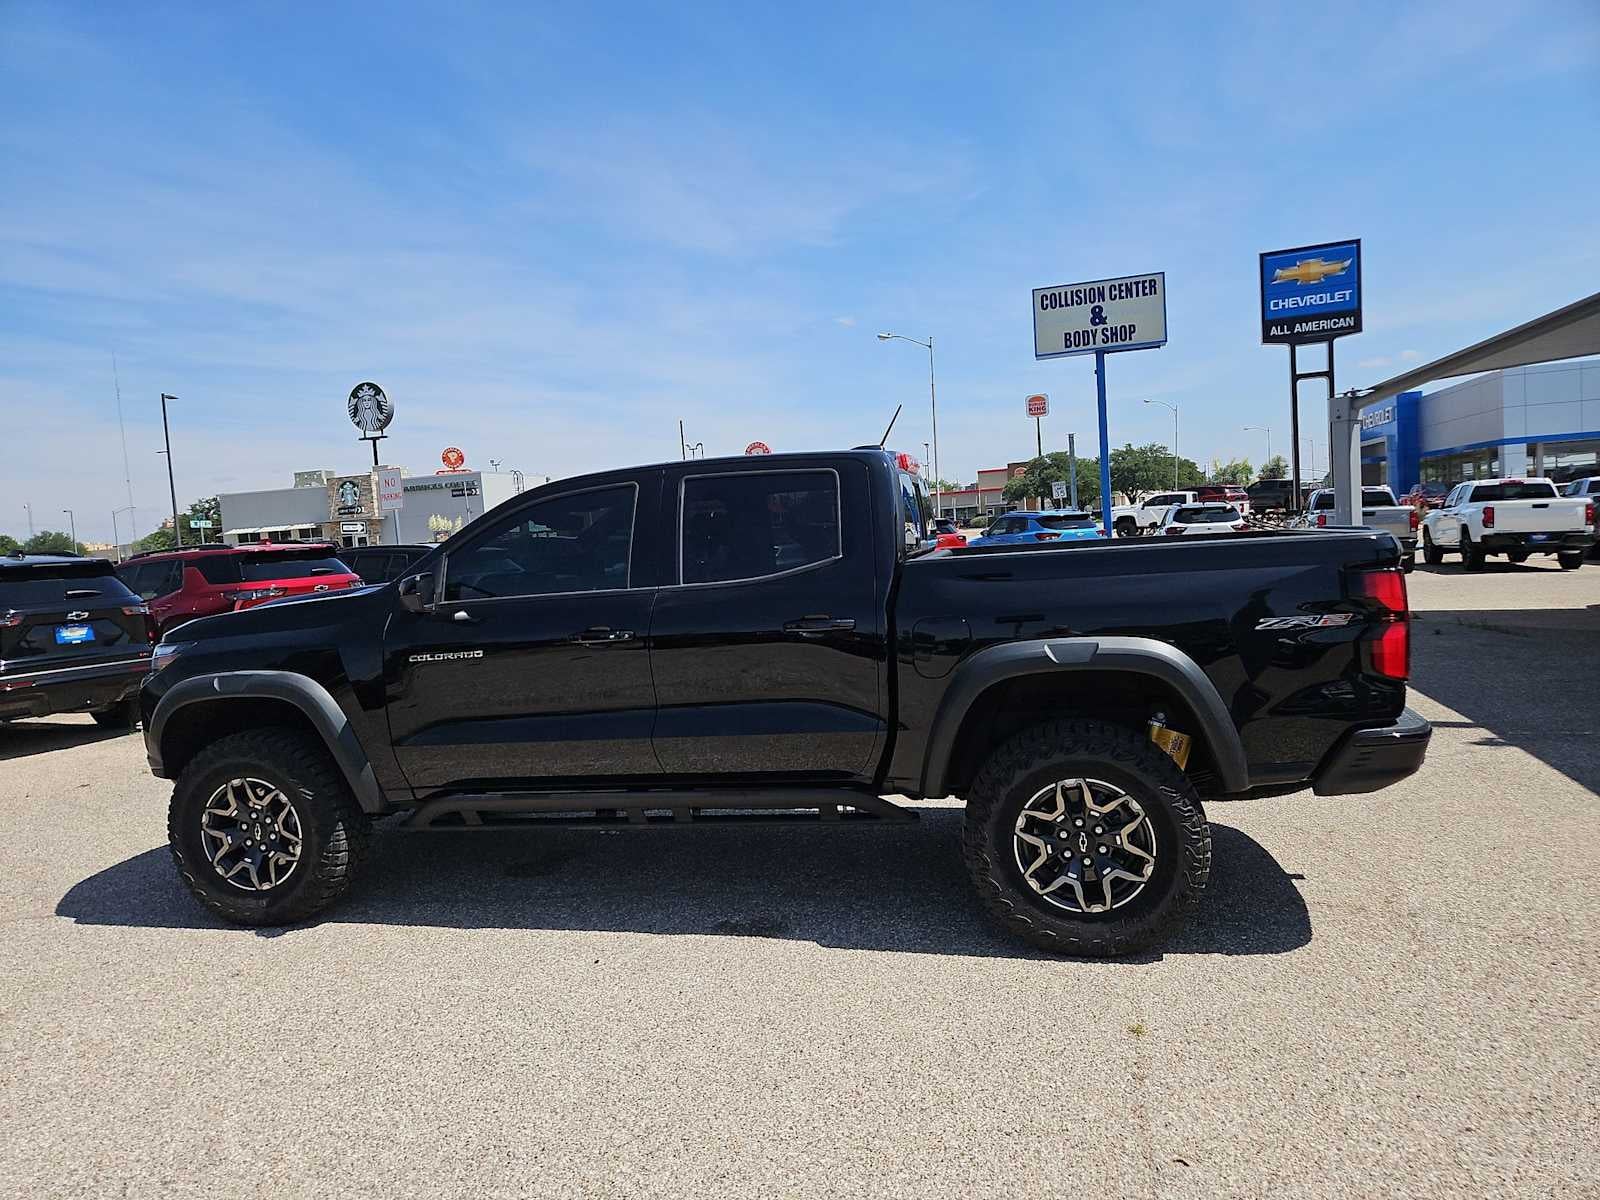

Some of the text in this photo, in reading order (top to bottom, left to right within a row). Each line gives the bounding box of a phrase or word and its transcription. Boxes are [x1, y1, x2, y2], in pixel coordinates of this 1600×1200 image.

[1040, 278, 1157, 311] COLLISION CENTER
[1270, 289, 1353, 311] CHEVROLET
[1090, 305, 1108, 327] &
[1270, 316, 1355, 336] ALL AMERICAN
[1064, 324, 1136, 349] BODY SHOP
[384, 478, 396, 488] NO
[1254, 613, 1353, 630] ZR2
[408, 650, 484, 662] COLORADO
